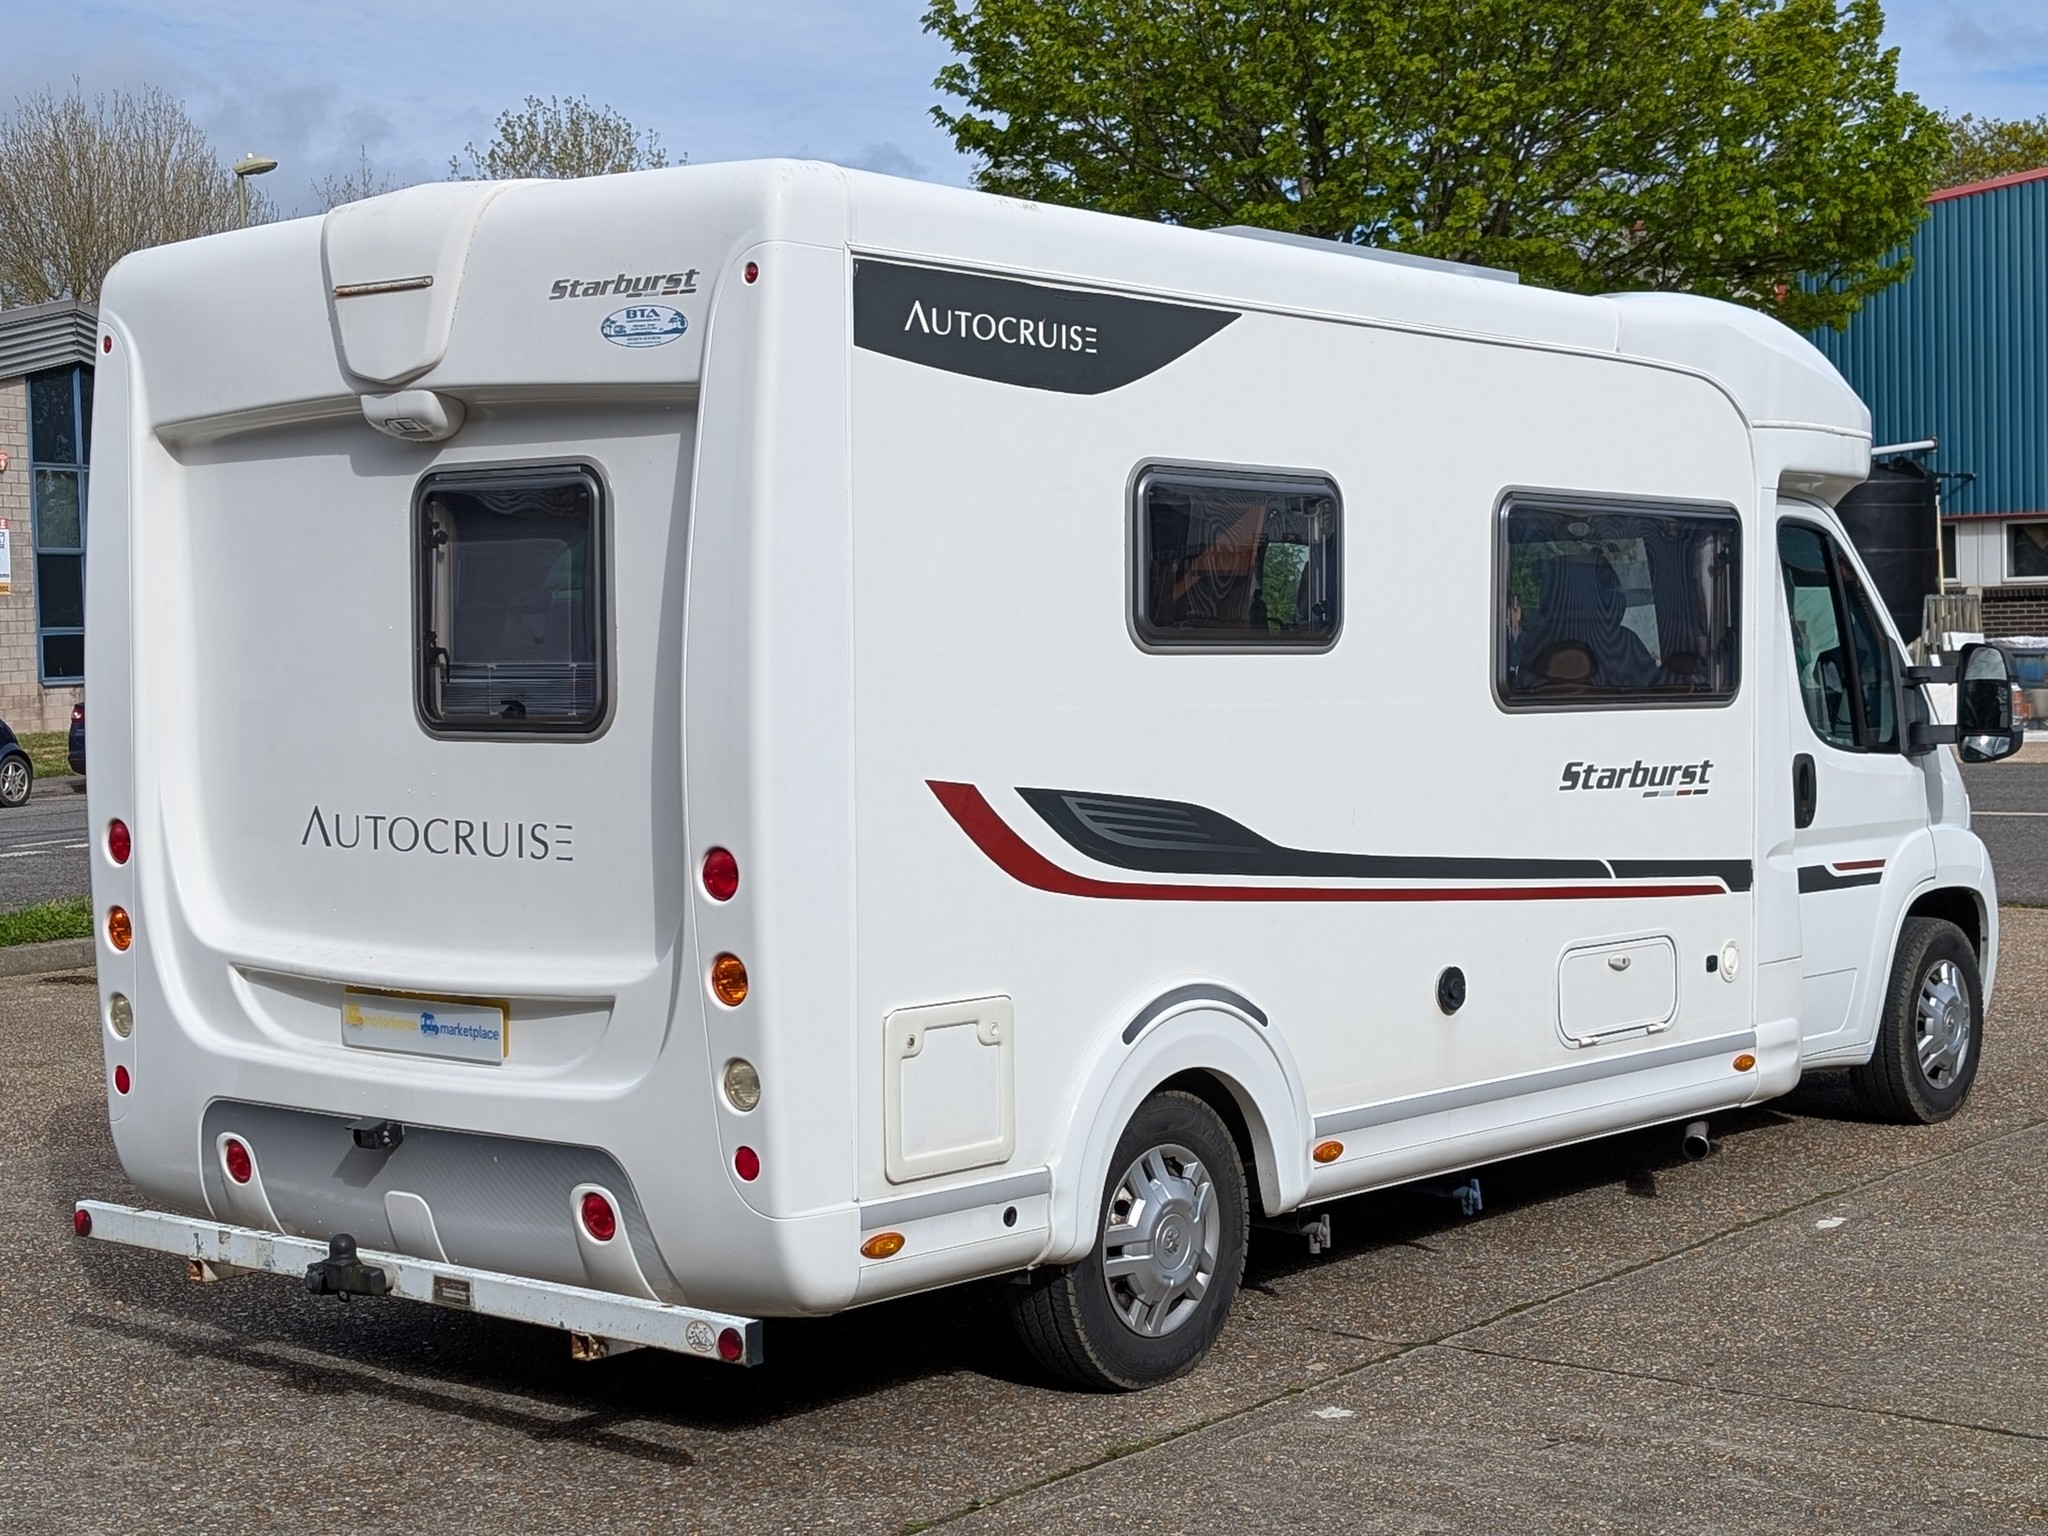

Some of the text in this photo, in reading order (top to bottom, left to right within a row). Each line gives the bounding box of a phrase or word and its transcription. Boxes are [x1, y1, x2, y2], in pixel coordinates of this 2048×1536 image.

[549, 268, 700, 300] Starburst
[626, 308, 660, 318] BTA
[904, 299, 1098, 354] AUTOCRUISE
[1559, 760, 1714, 791] Starburst
[301, 804, 574, 862] AUTOCRUISE
[364, 1015, 500, 1041] motorhome marketplace
